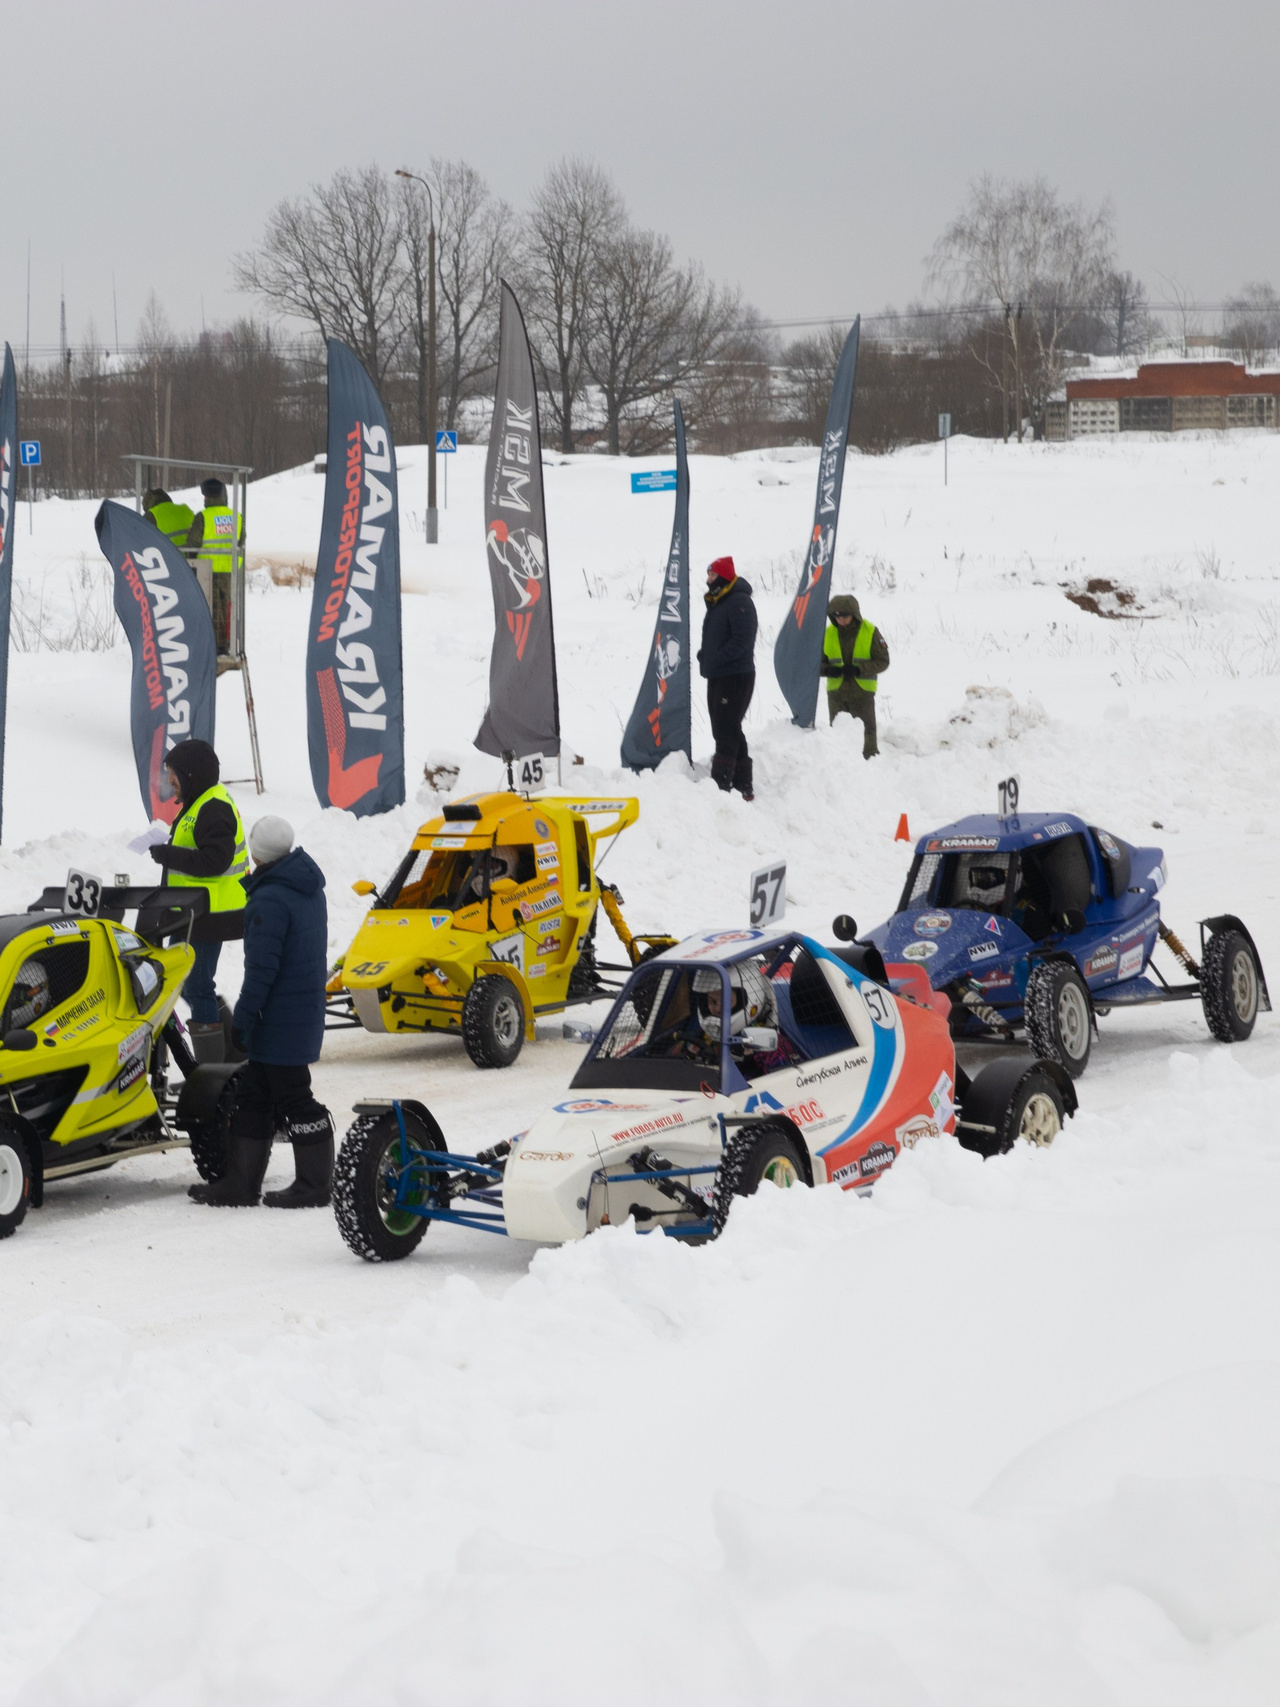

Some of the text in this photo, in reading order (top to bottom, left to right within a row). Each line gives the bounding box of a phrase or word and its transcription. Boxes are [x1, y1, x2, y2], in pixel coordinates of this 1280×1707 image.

[521, 758, 543, 786] 45
[998, 777, 1019, 814] 79
[942, 838, 998, 847] KRAMAR
[1045, 823, 1071, 838] RUSTA
[68, 873, 100, 915] 33
[531, 895, 562, 914] TAKAYAMA
[750, 865, 787, 924] 57
[350, 961, 390, 976] 45
[56, 988, 106, 1030] МАРЧЕНКО ЗАХАР
[863, 989, 889, 1021] 57
[120, 1061, 145, 1089] KRAMAR
[844, 1056, 868, 1071] Алина
[610, 1112, 684, 1142] WWW.FOBOS-AVTO.RU
[520, 1150, 573, 1162] Garde
[862, 1150, 894, 1170] KRAMAR
